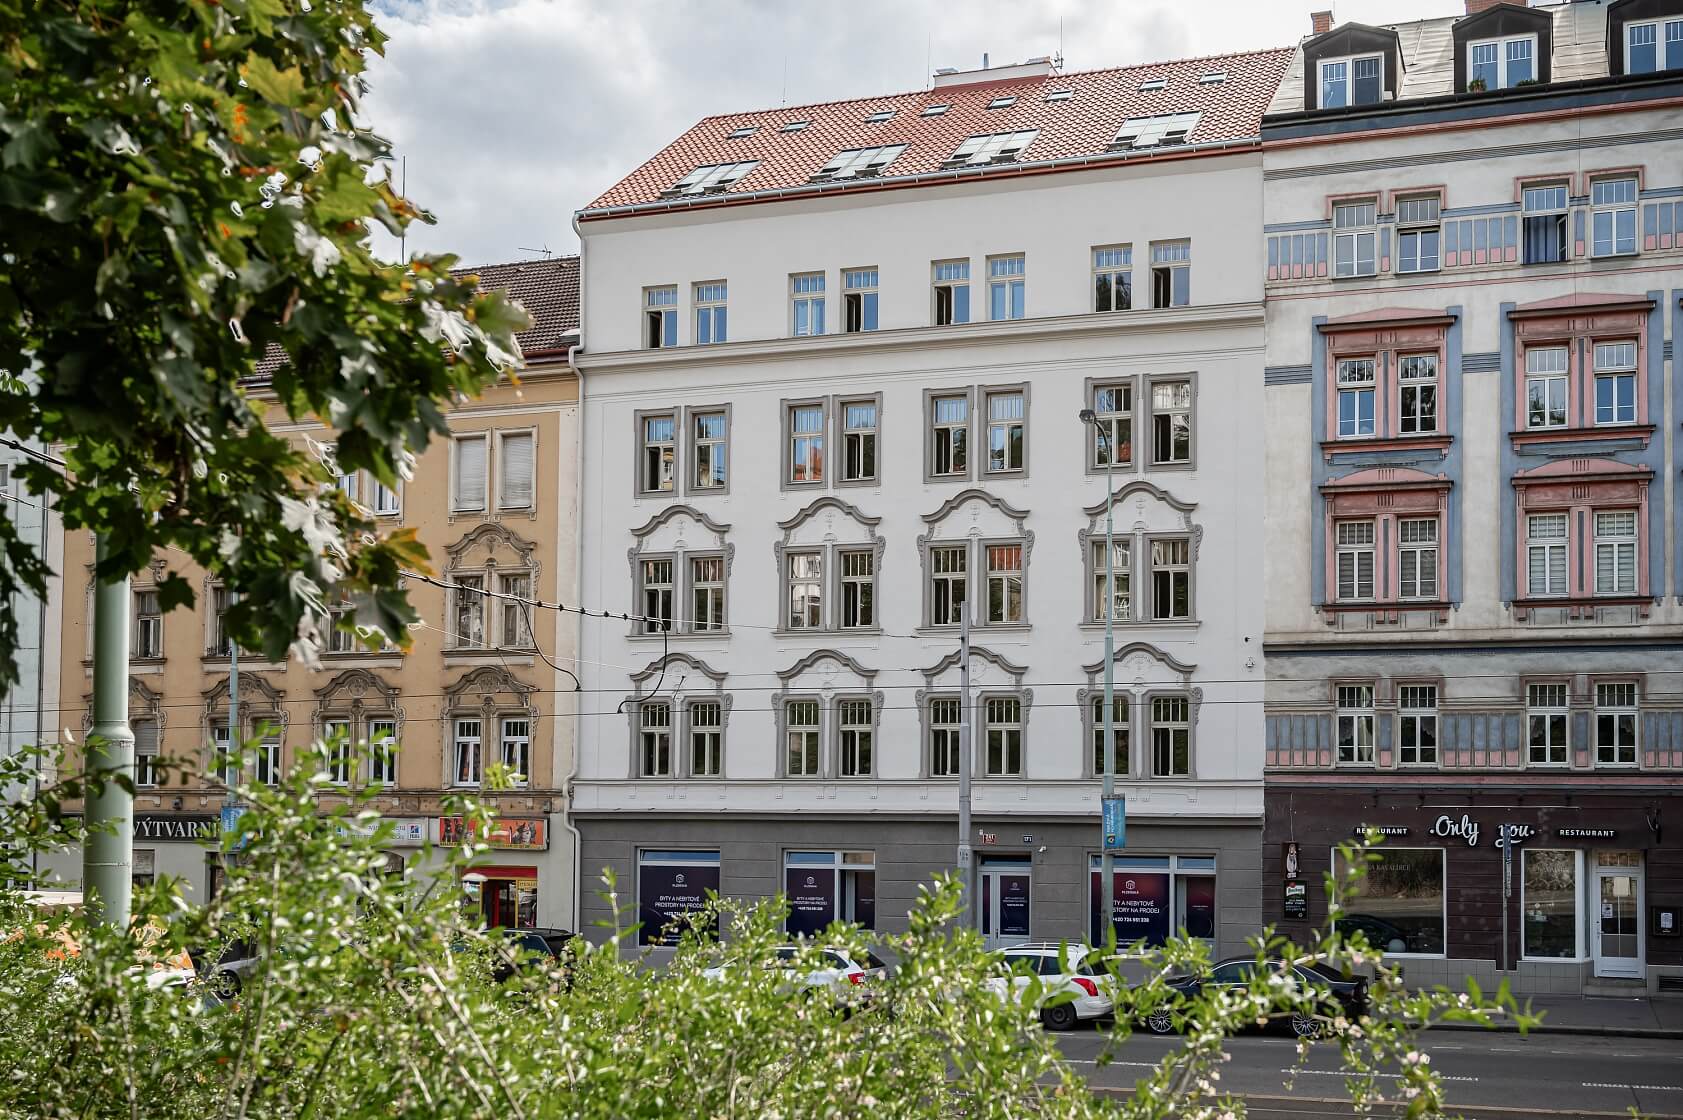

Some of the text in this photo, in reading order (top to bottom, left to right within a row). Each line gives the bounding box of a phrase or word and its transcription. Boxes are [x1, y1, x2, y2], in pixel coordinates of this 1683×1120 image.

[132, 817, 218, 837] VÝTVARN
[1435, 814, 1480, 846] Only
[1559, 829, 1615, 837] RESTAURANT
